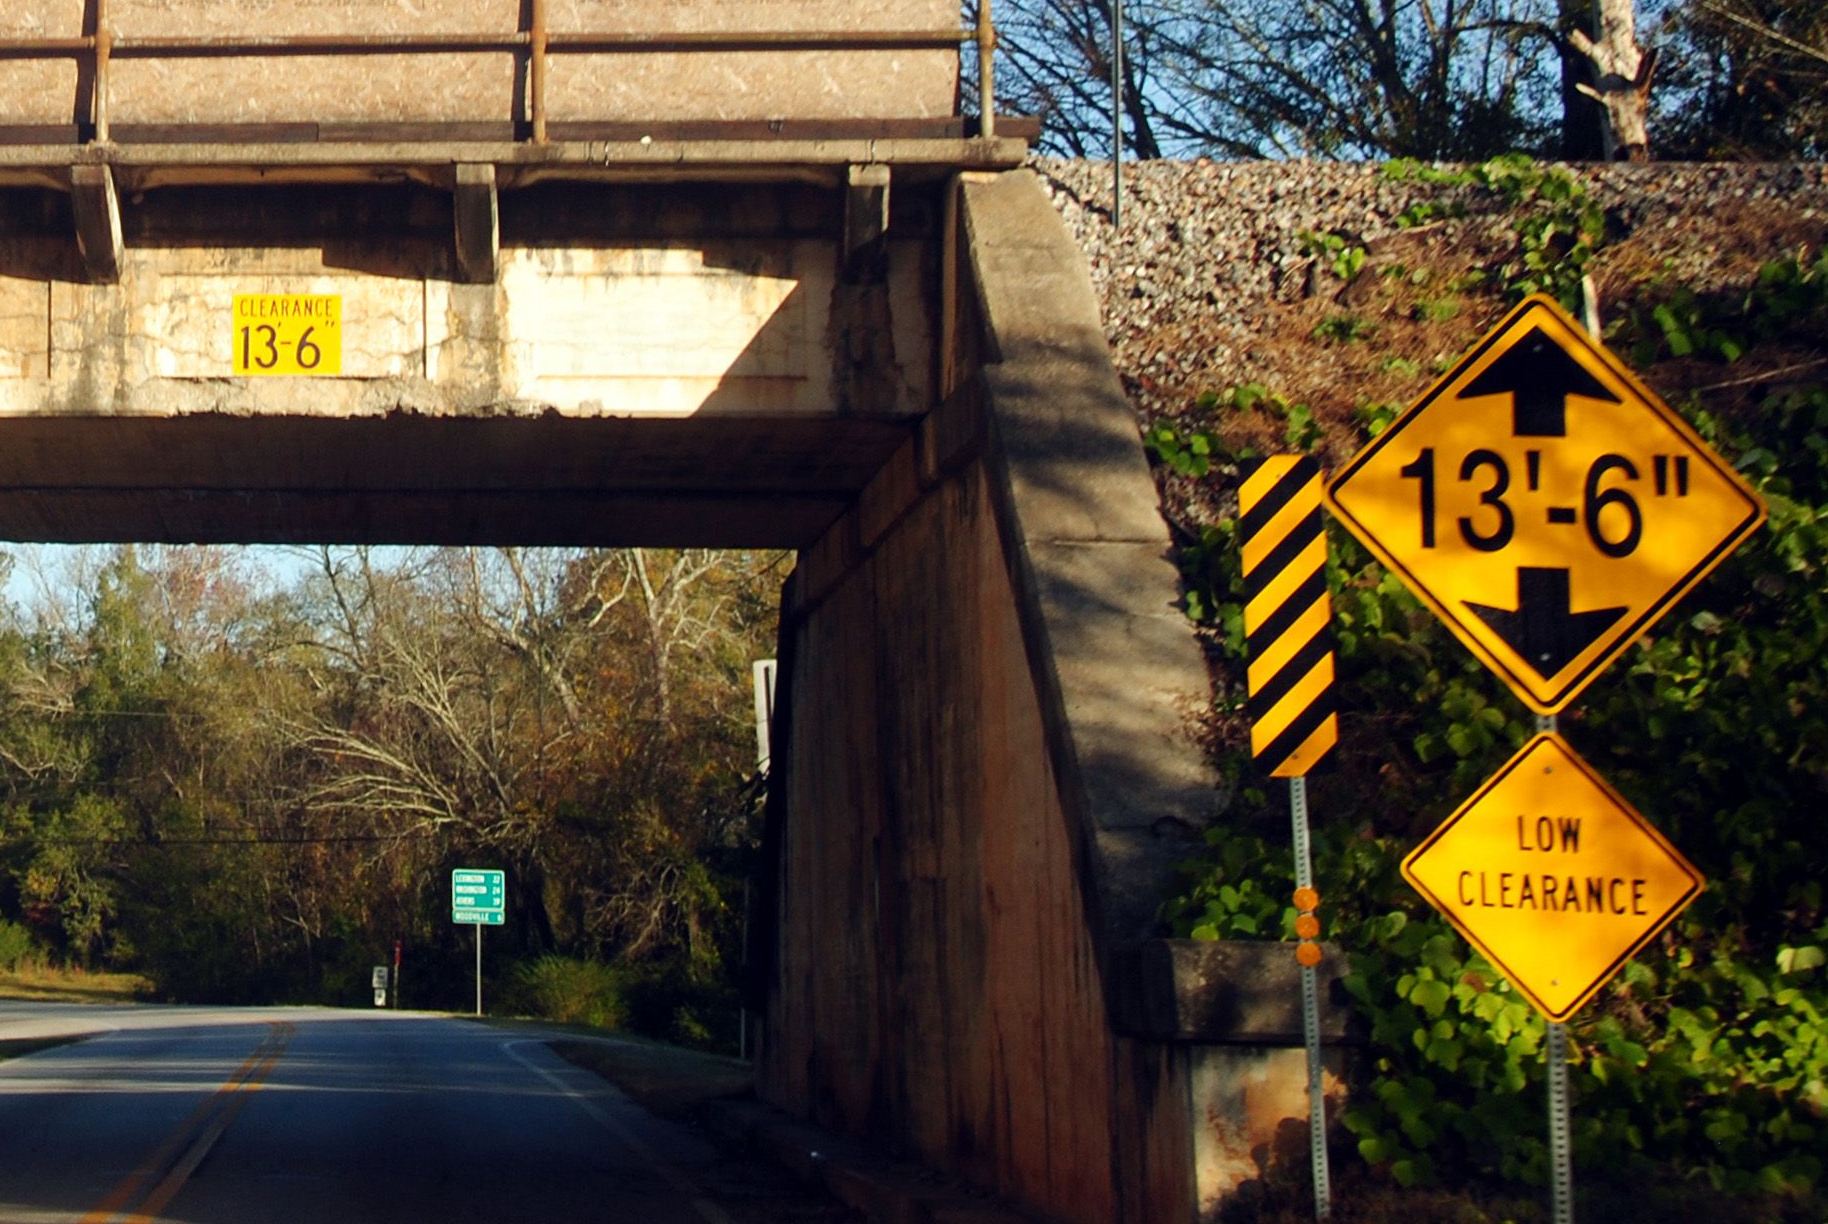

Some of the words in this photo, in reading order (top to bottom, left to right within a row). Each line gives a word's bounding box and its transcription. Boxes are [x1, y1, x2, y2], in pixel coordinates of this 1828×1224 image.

[239, 298, 333, 318] CLEARANCE
[240, 320, 336, 369] 13'-6"
[1401, 448, 1689, 558] 13'-6"
[1517, 815, 1581, 853] LOW
[1458, 871, 1648, 915] CLEARANCE
